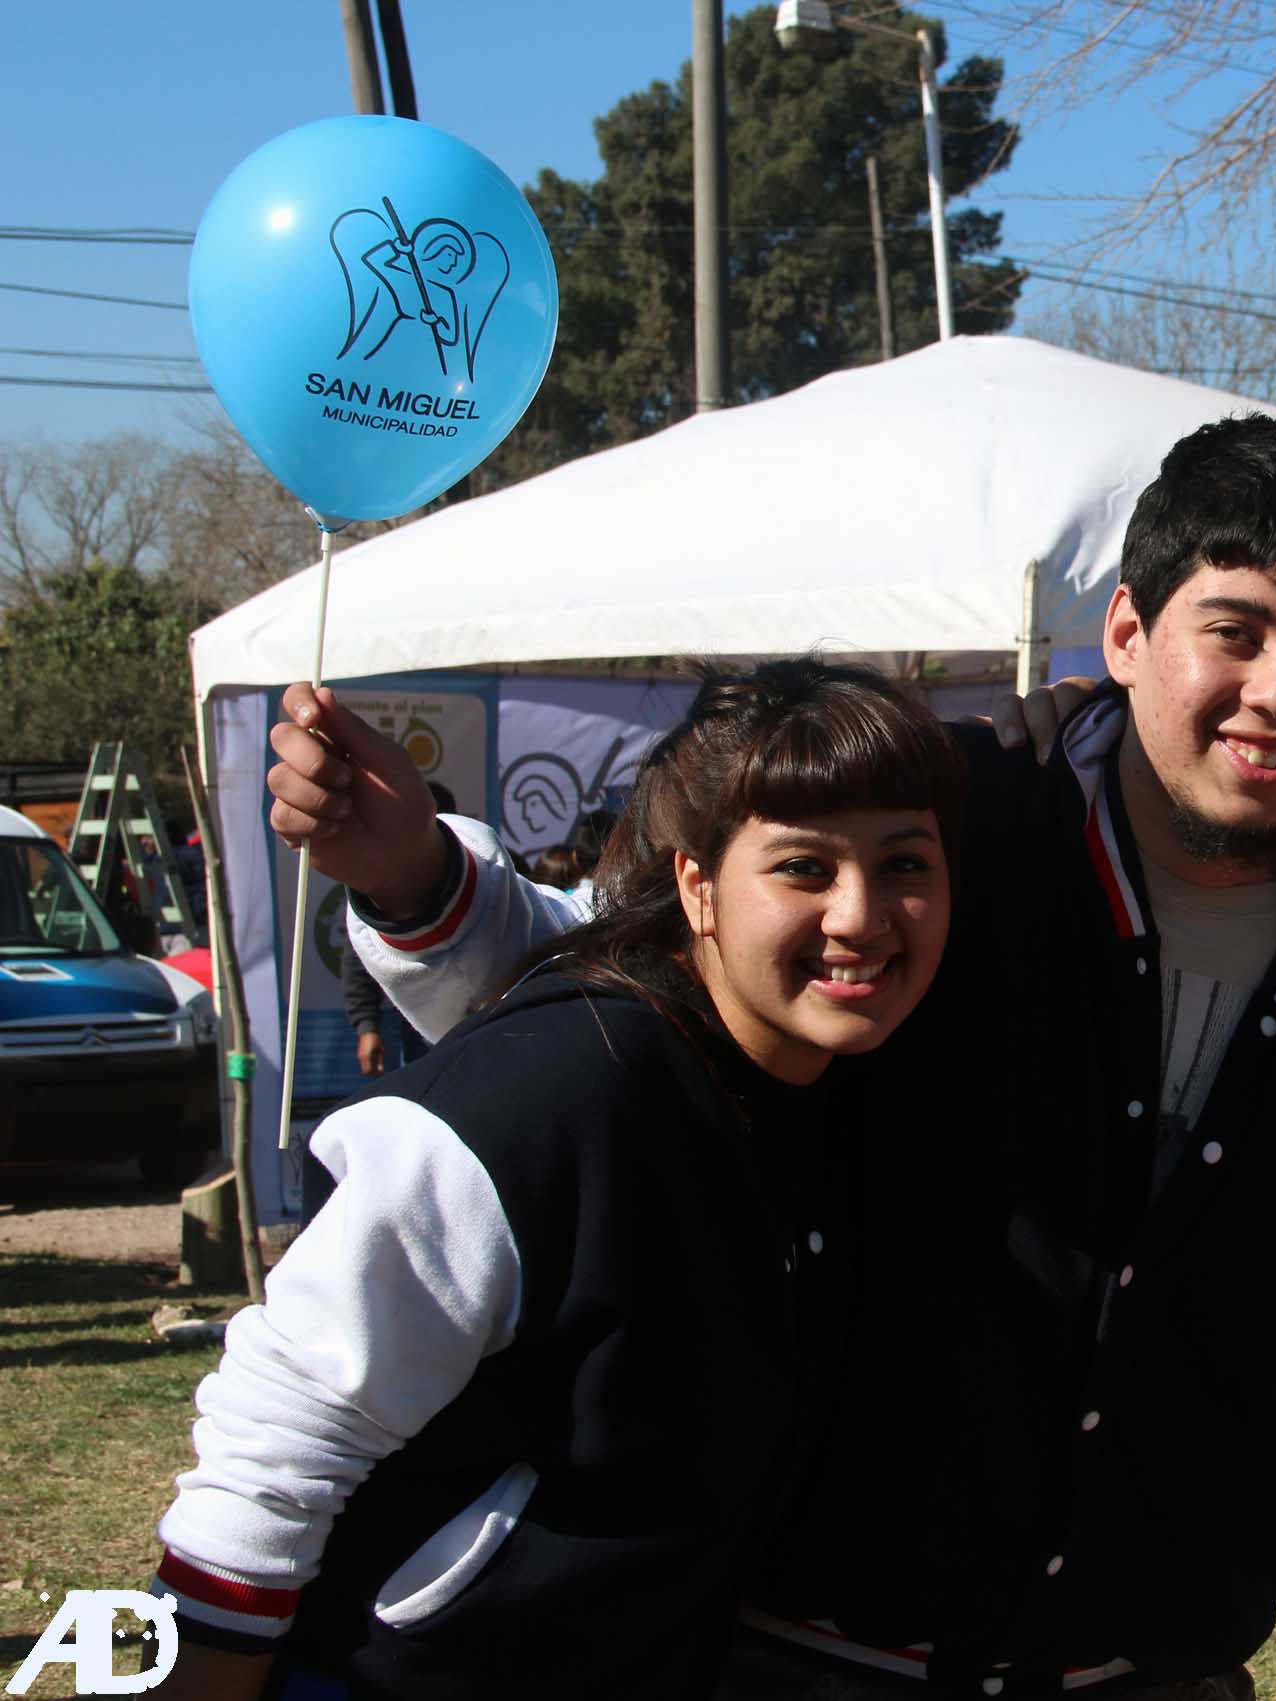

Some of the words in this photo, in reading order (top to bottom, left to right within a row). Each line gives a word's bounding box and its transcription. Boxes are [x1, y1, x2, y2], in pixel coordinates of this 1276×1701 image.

[305, 373, 371, 405] SAN
[376, 387, 481, 420] MIGUEL
[322, 405, 457, 437] MUNICIPALIDAD
